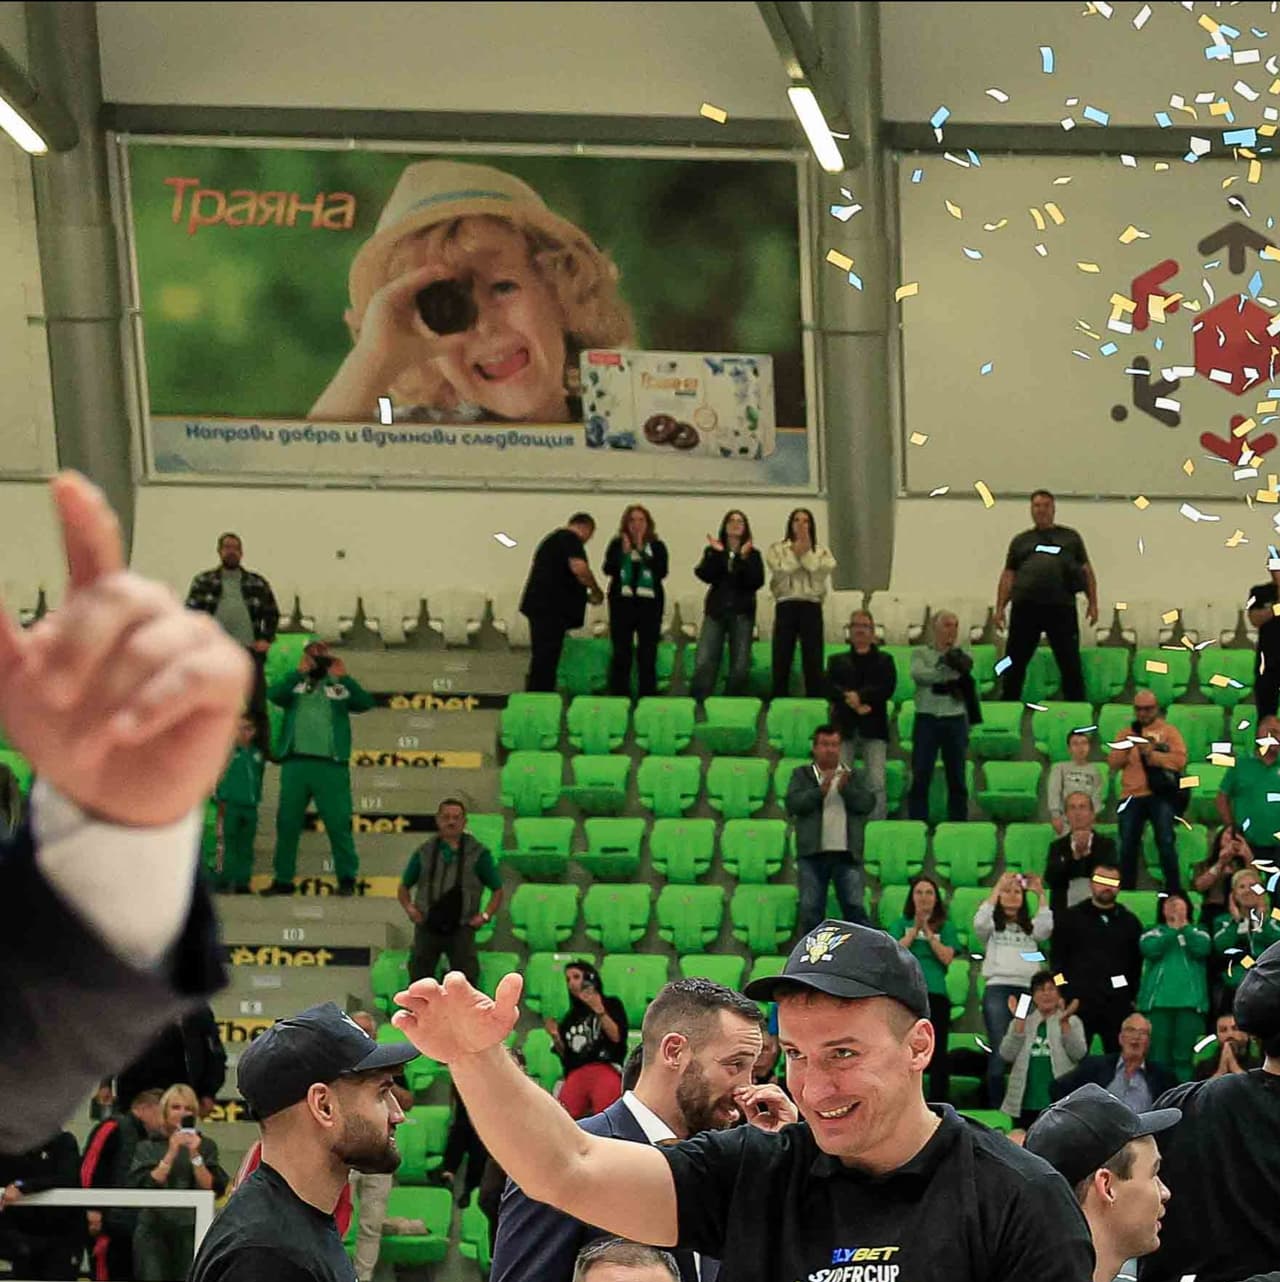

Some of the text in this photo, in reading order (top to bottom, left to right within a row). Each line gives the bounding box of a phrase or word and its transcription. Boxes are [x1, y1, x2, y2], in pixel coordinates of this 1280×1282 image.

[163, 177, 357, 235] Траяна
[185, 424, 275, 445] Направи
[363, 425, 456, 449] вдъхнови
[460, 429, 575, 450] следващия
[389, 692, 480, 712] efbet
[232, 946, 334, 967] efbet
